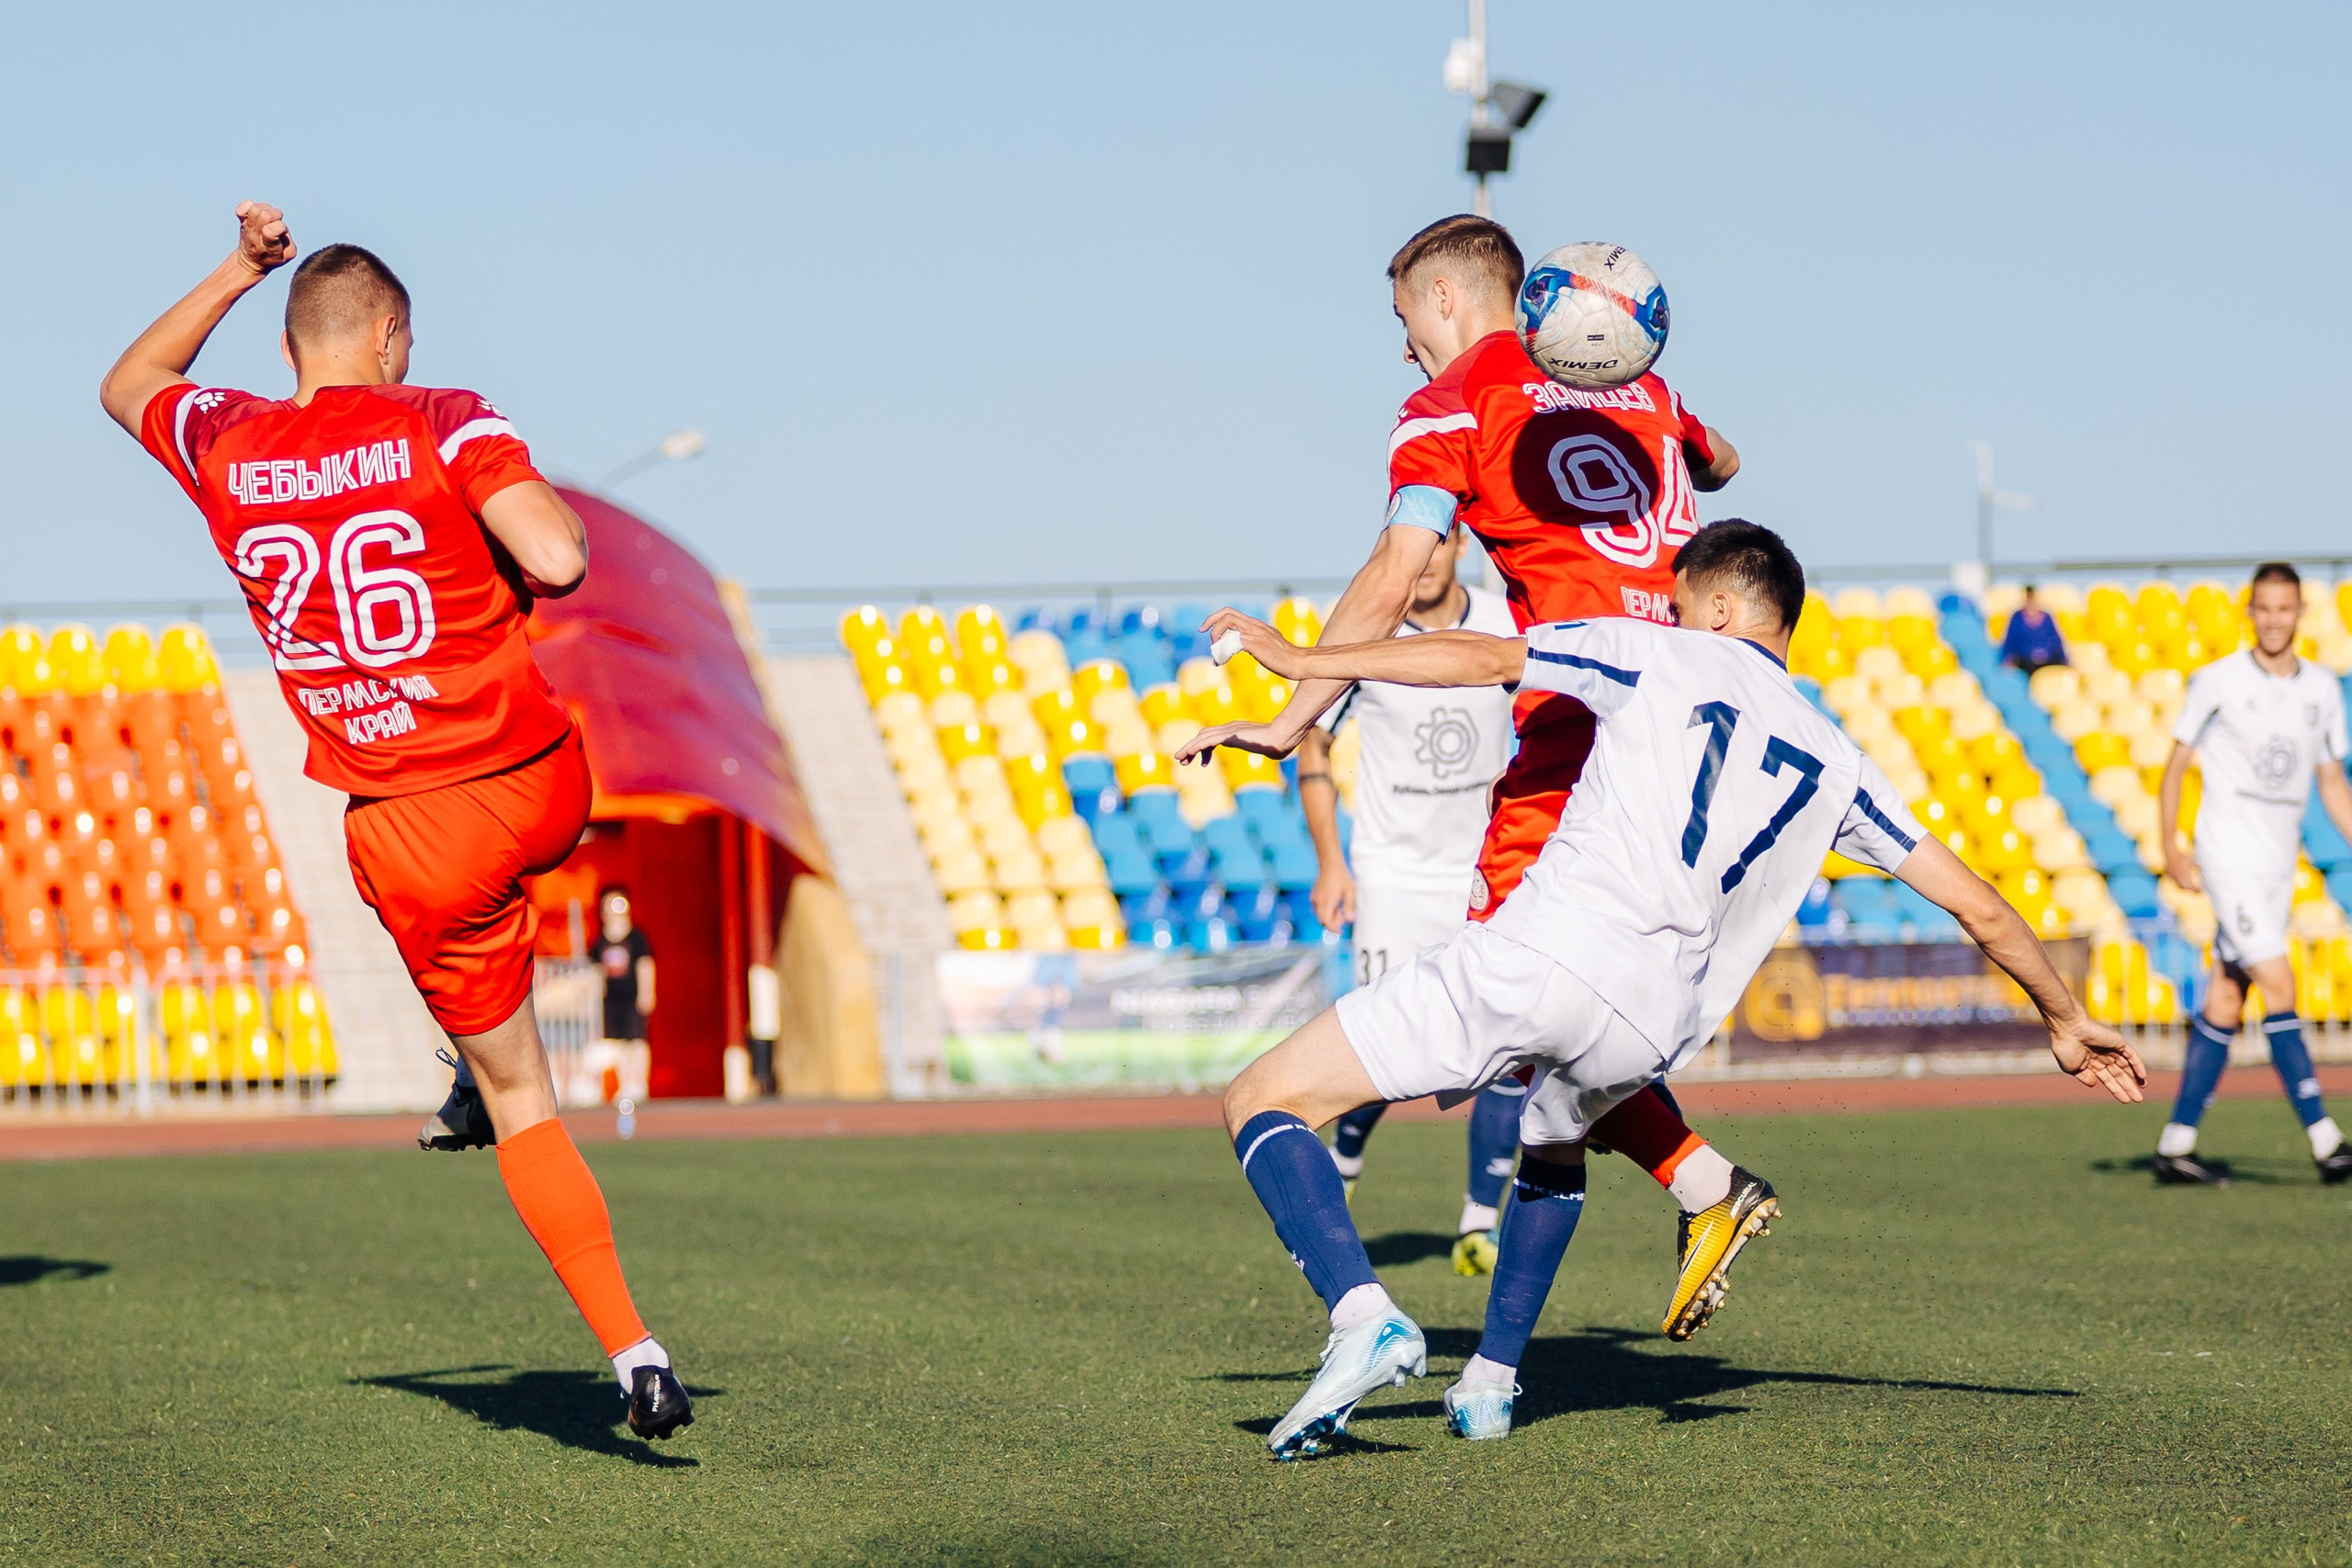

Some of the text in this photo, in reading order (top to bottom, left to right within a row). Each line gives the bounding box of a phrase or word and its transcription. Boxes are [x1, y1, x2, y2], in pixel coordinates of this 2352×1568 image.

[1603, 245, 1626, 272] EMIX
[1549, 357, 1619, 369] DEMIX
[228, 438, 412, 505] ЧЕБЫКИН
[1548, 434, 1699, 569] 94
[234, 509, 437, 671] 26
[1620, 585, 1675, 623] ПЕРМ
[298, 674, 439, 716] ПЕРМСКИЙ
[344, 701, 417, 745] КРАЙ
[1681, 701, 1826, 896] 17
[1729, 1181, 1758, 1219] MERCURIAL
